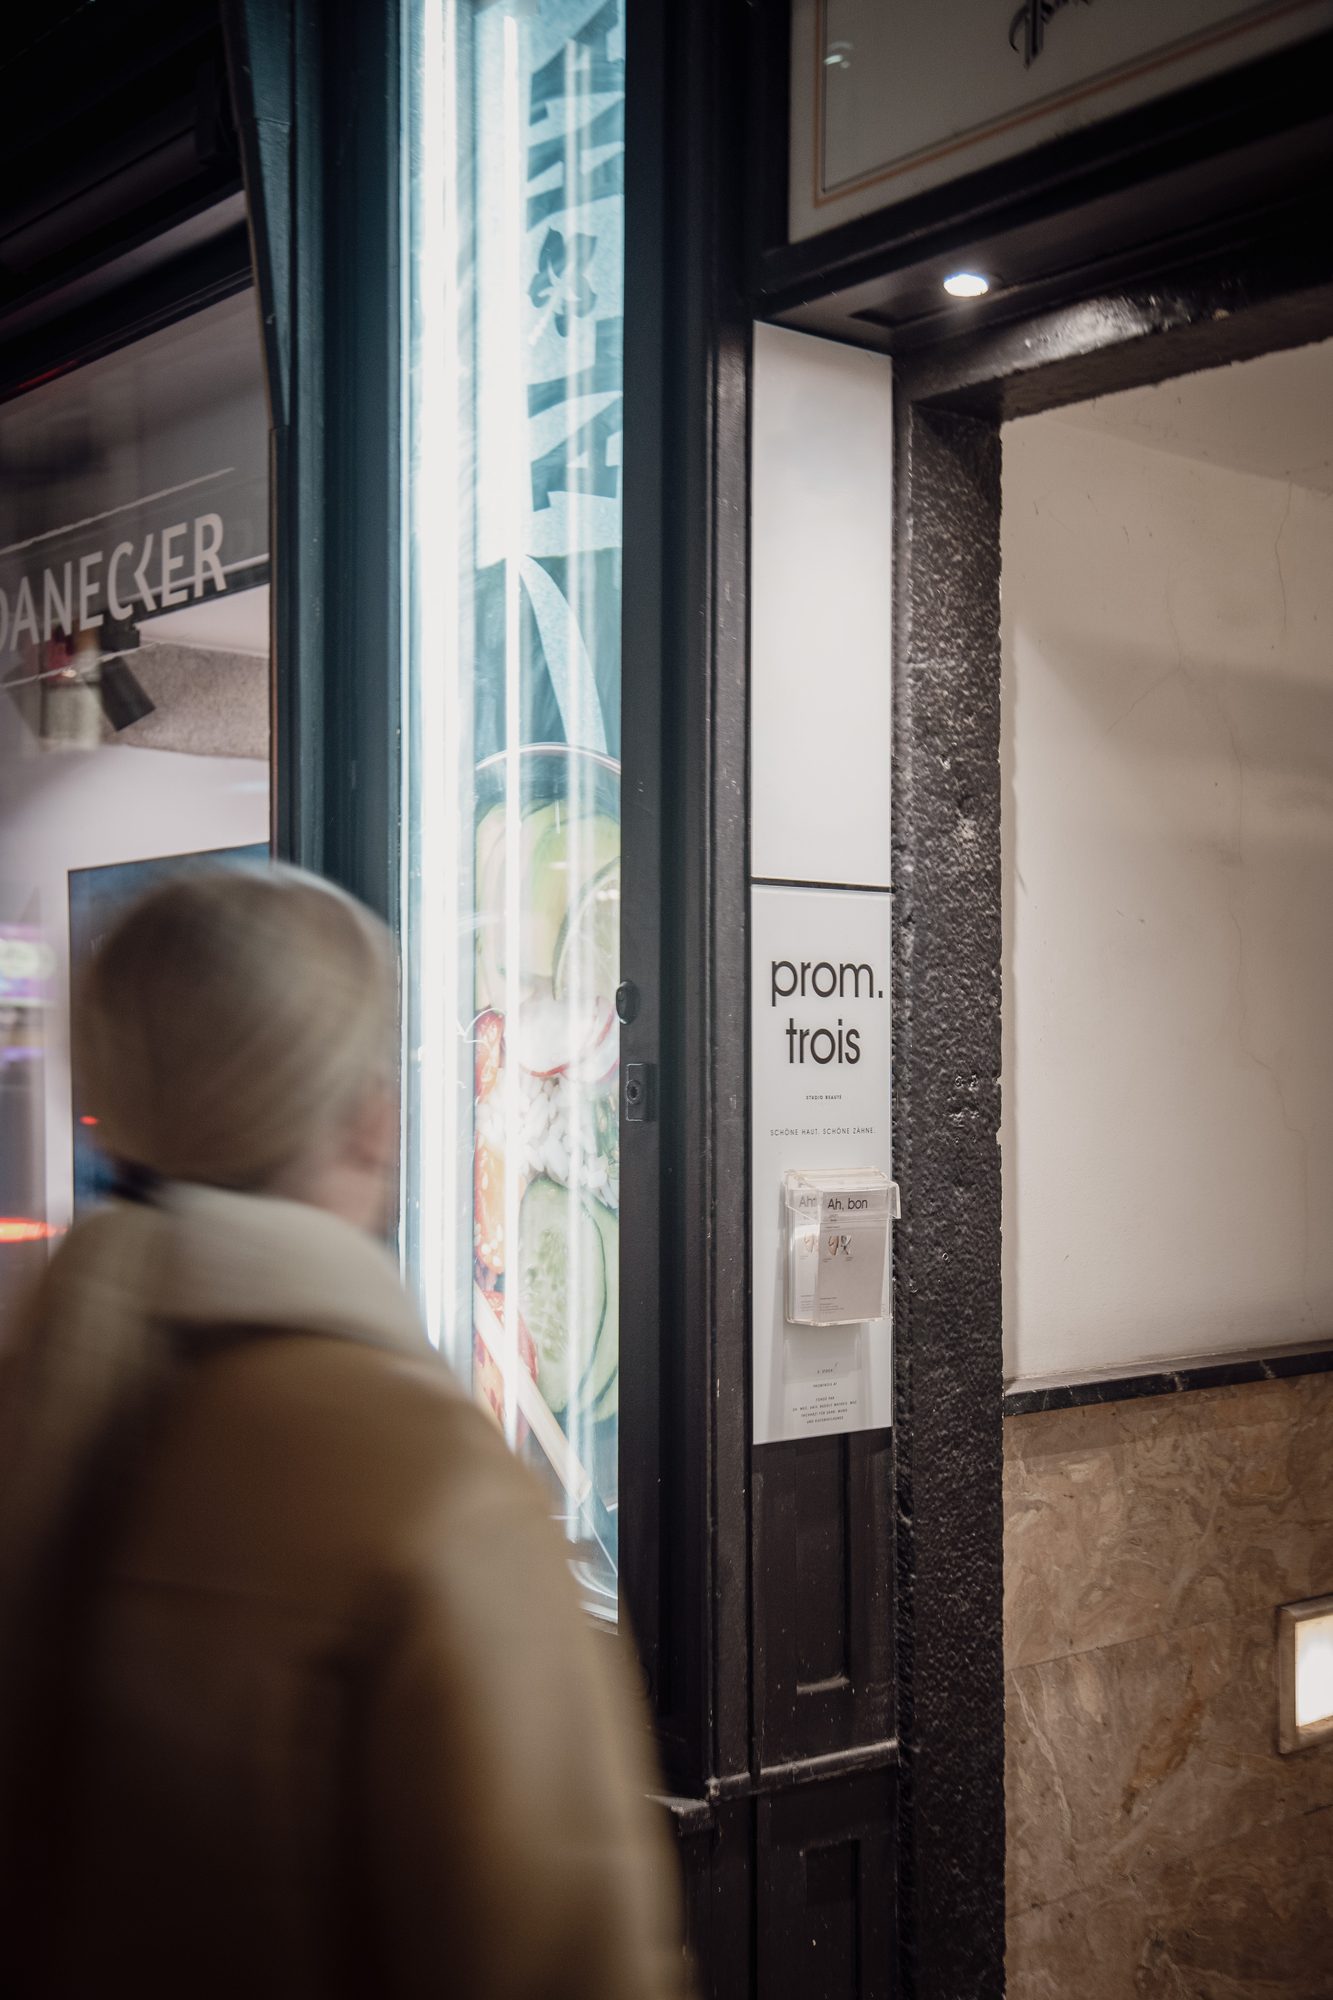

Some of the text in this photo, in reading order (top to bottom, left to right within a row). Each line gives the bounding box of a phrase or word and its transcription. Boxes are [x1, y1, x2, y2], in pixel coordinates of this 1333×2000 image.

[771, 960, 884, 1008] prom.
[785, 1017, 861, 1065] trois
[770, 1128, 798, 1136] SCHÖNE
[822, 1127, 850, 1135] SCHÖNE
[827, 1198, 868, 1211] Ah, bon
